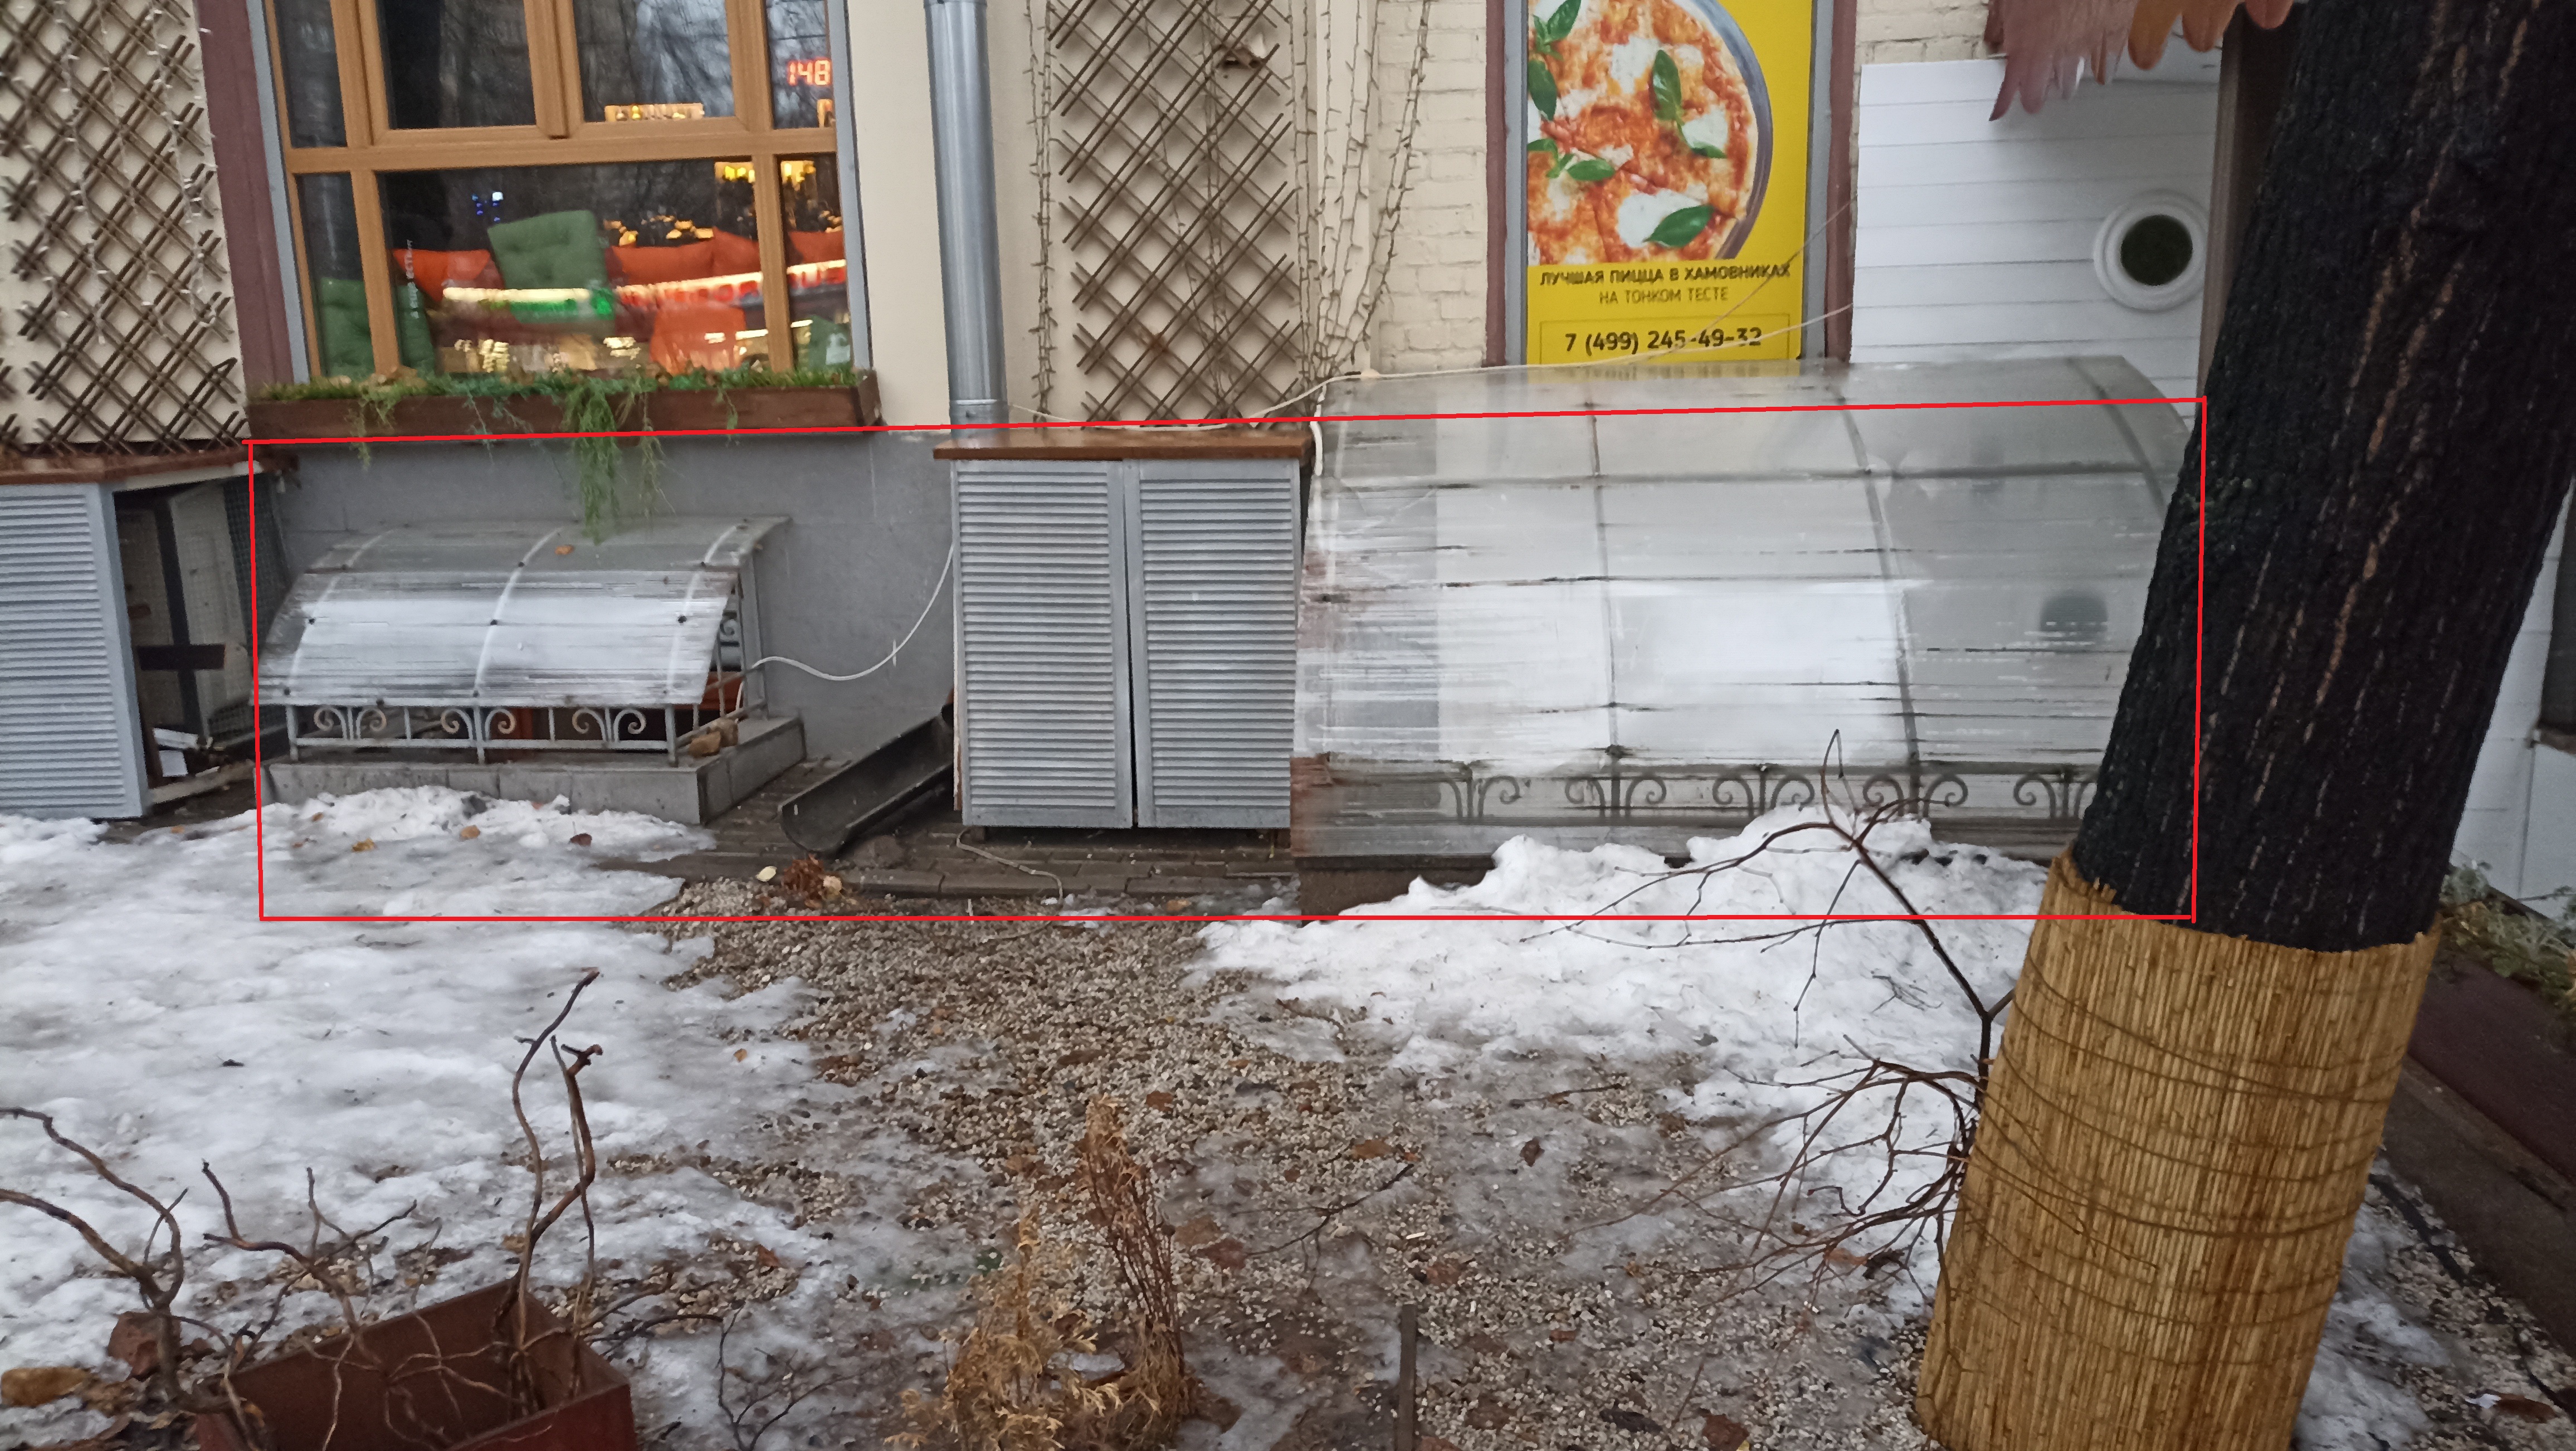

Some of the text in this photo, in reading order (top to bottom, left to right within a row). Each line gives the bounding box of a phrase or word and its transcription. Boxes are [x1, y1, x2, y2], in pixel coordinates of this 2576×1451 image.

[789, 59, 831, 85] 148
[1540, 263, 1790, 285] ЛУЧШАЯ ПИЦЦА В ХАМОВНИКАХ
[1599, 286, 1729, 304] НА ТОНКОМ ТЕСТЕ
[1565, 327, 1762, 357] 7 (499) 245-49-32
